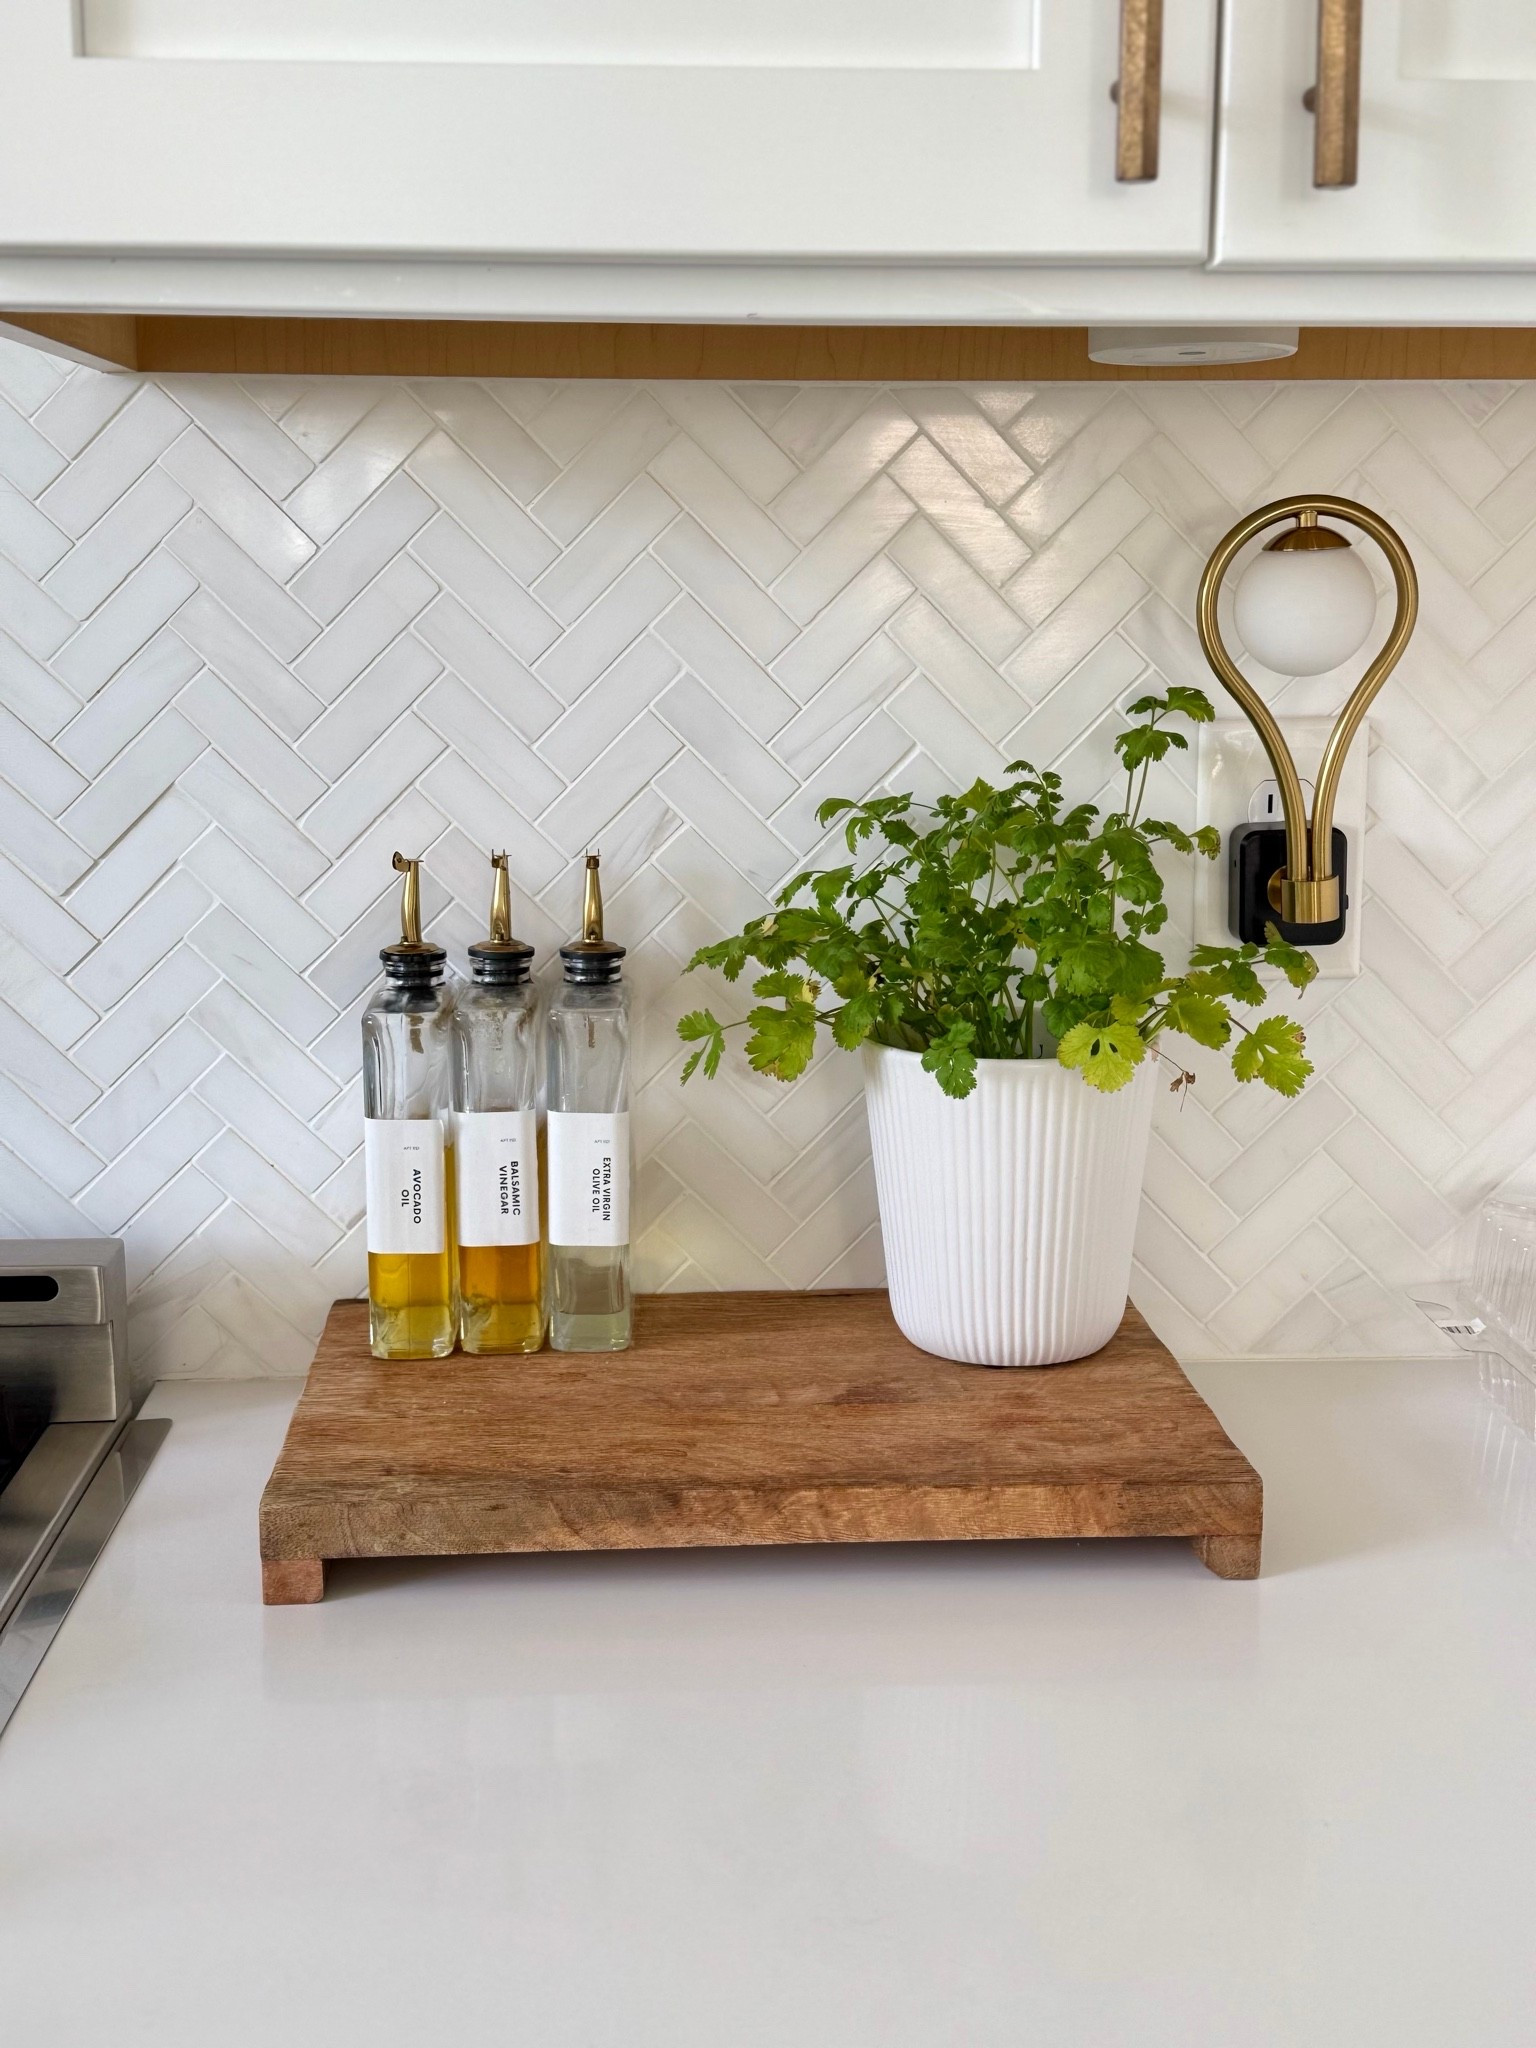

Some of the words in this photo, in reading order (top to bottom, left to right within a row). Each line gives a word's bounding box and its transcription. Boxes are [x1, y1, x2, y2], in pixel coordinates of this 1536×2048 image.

[592, 1168, 600, 1194] OLIVE
[602, 1157, 611, 1185] EXTRA
[401, 1189, 409, 1207] OIL
[413, 1168, 421, 1224] AVOCADO
[499, 1165, 509, 1214] VINEGAR
[510, 1161, 521, 1216] BALSAMIC
[602, 1187, 611, 1221] VIRGIN
[592, 1197, 600, 1212] OIL
